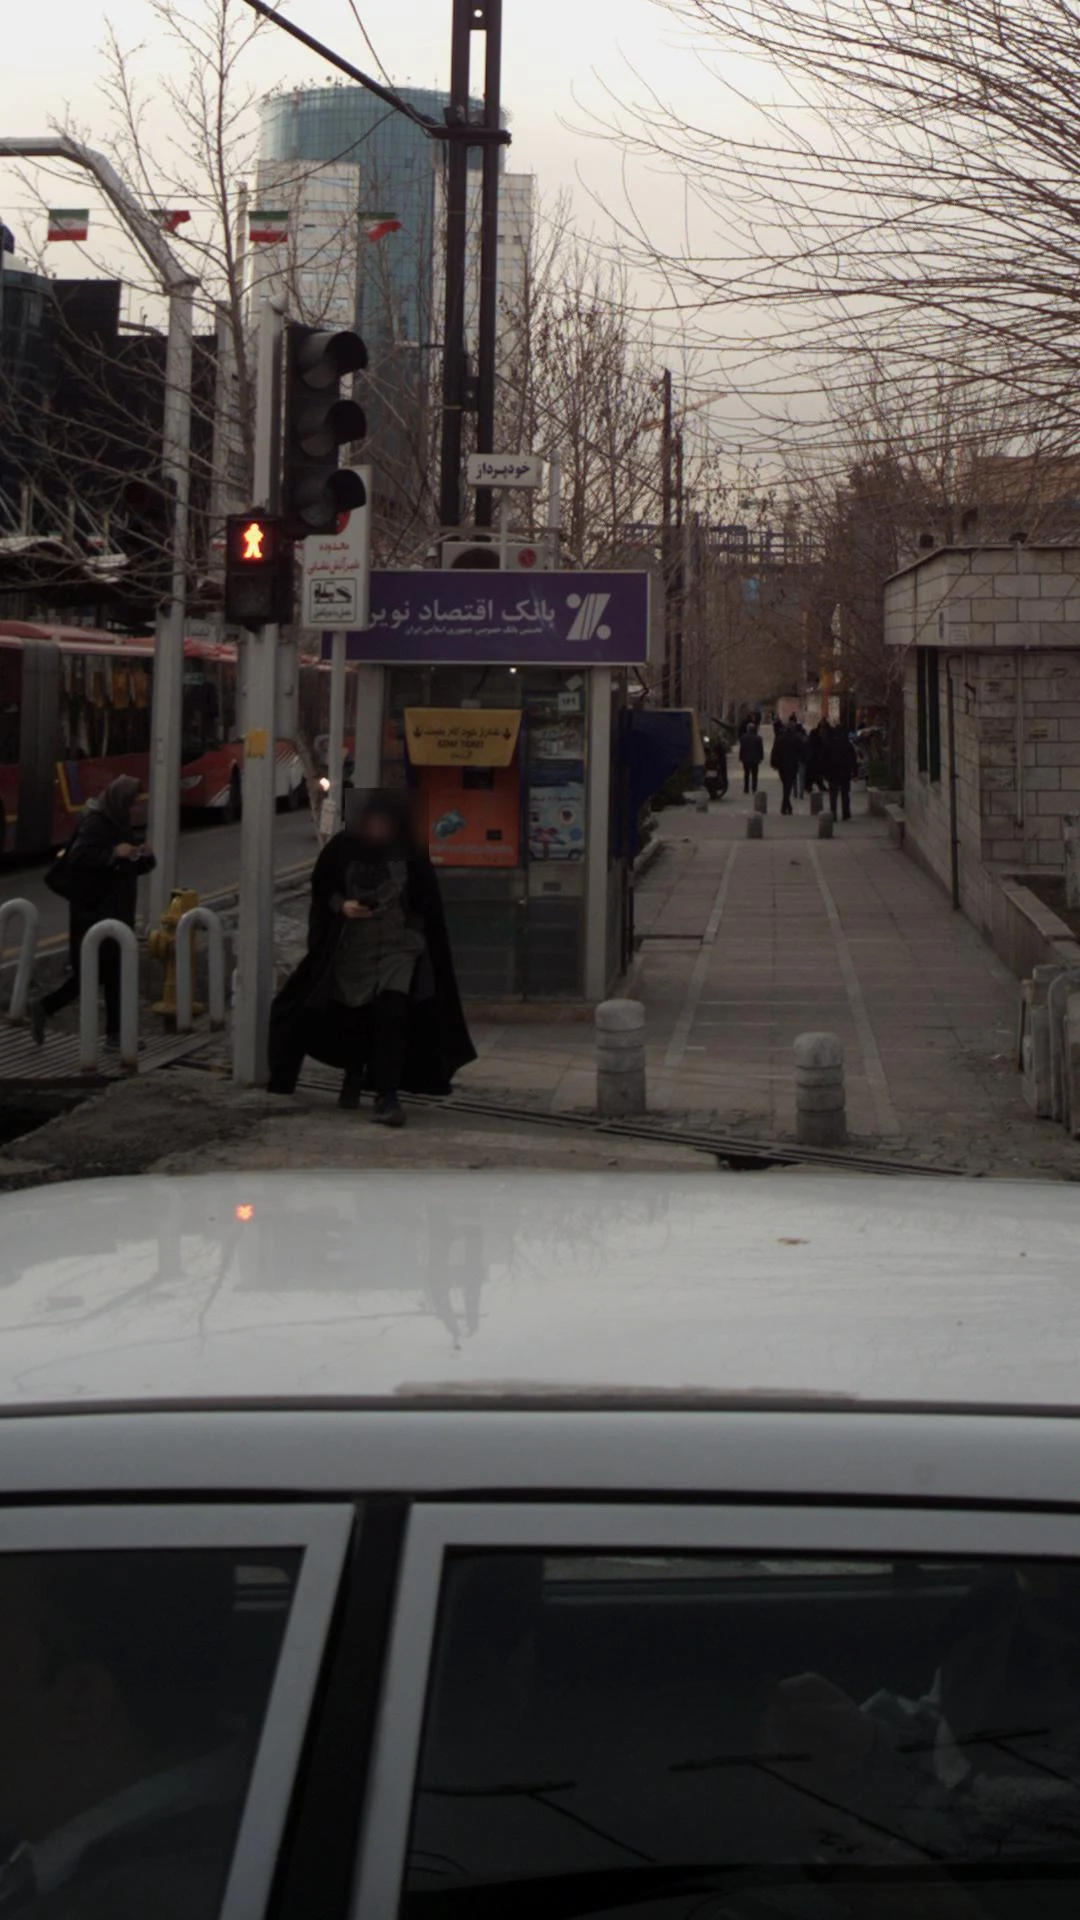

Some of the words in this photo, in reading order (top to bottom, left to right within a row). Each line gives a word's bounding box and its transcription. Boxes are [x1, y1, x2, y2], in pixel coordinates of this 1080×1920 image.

[476, 461, 530, 480] خودپرداز
[418, 597, 494, 622] اقتصاد
[501, 598, 556, 629] بانک
